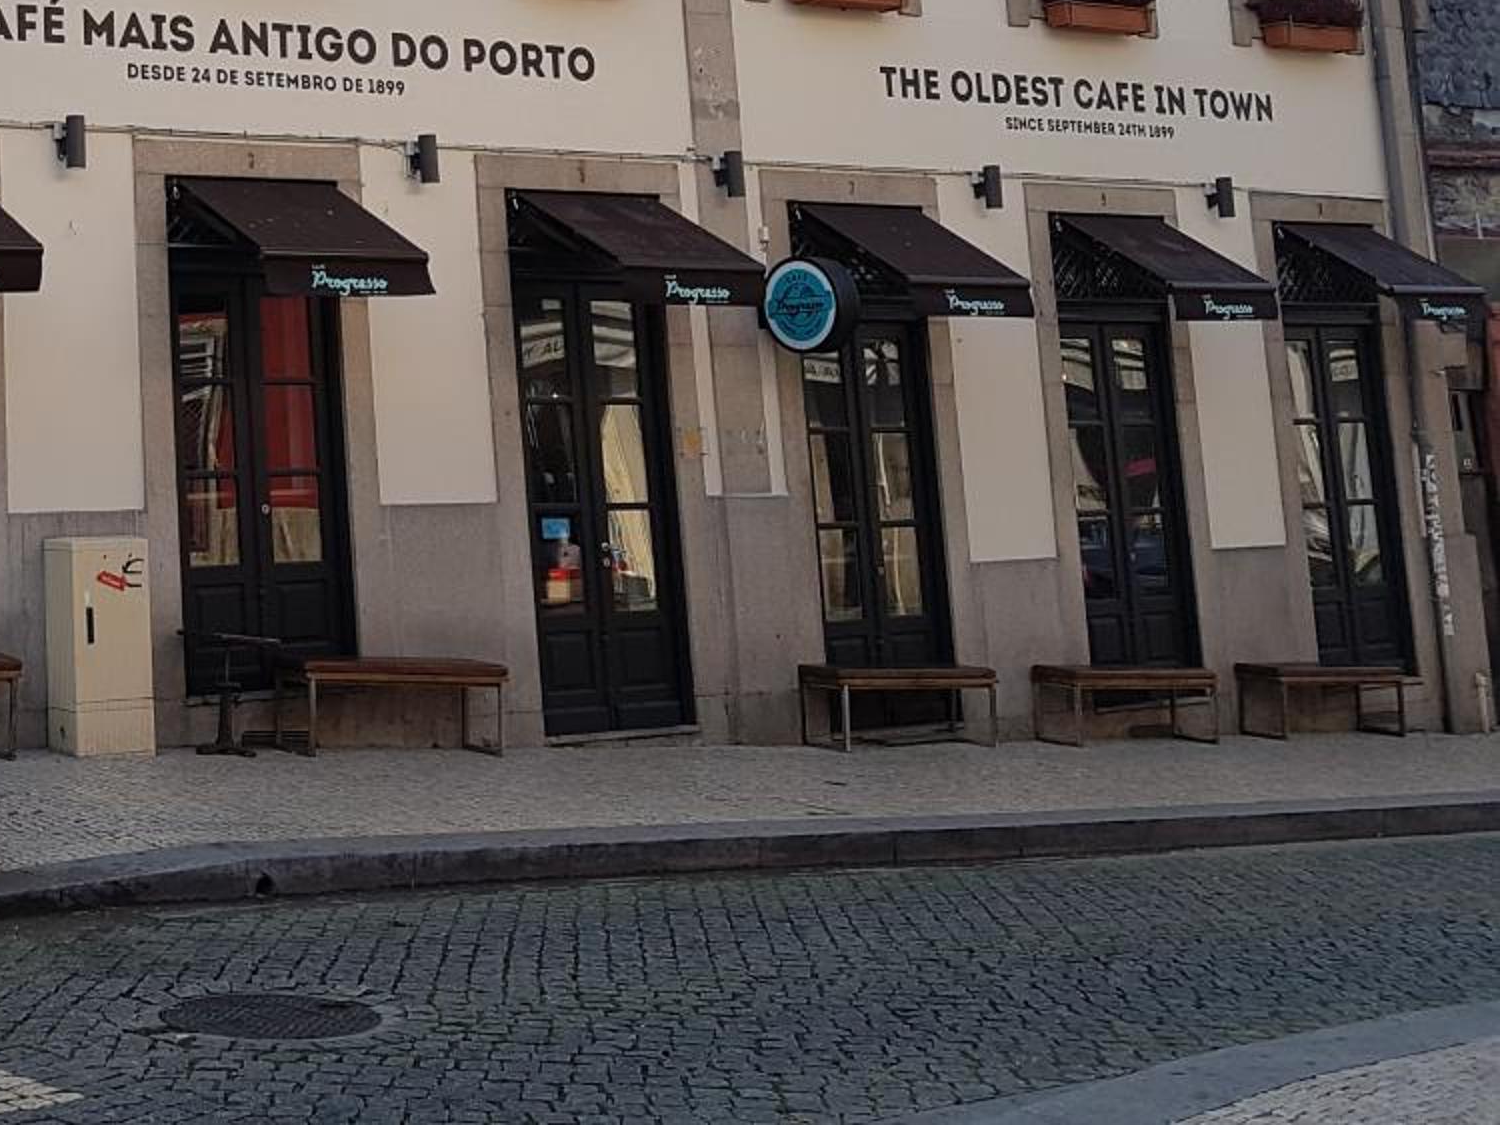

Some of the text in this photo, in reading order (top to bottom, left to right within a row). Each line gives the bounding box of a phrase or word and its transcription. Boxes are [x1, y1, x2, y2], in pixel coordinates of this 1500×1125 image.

[82, 8, 195, 53] MAIS
[208, 18, 377, 65] ANTIGO
[391, 32, 449, 71] DO
[463, 38, 595, 82] PORTO
[127, 62, 405, 96] DESDE 24 DE SETEMBRO DE 1899
[879, 65, 1274, 123] THE OLDEST CAFE IN TOWN
[1005, 116, 1175, 140] SINCE SEPTEMBER 24TH 1899
[311, 270, 389, 296] Progresso
[665, 280, 731, 303] Progresso
[947, 293, 1005, 316] Progresso
[1203, 298, 1254, 320] Progresso
